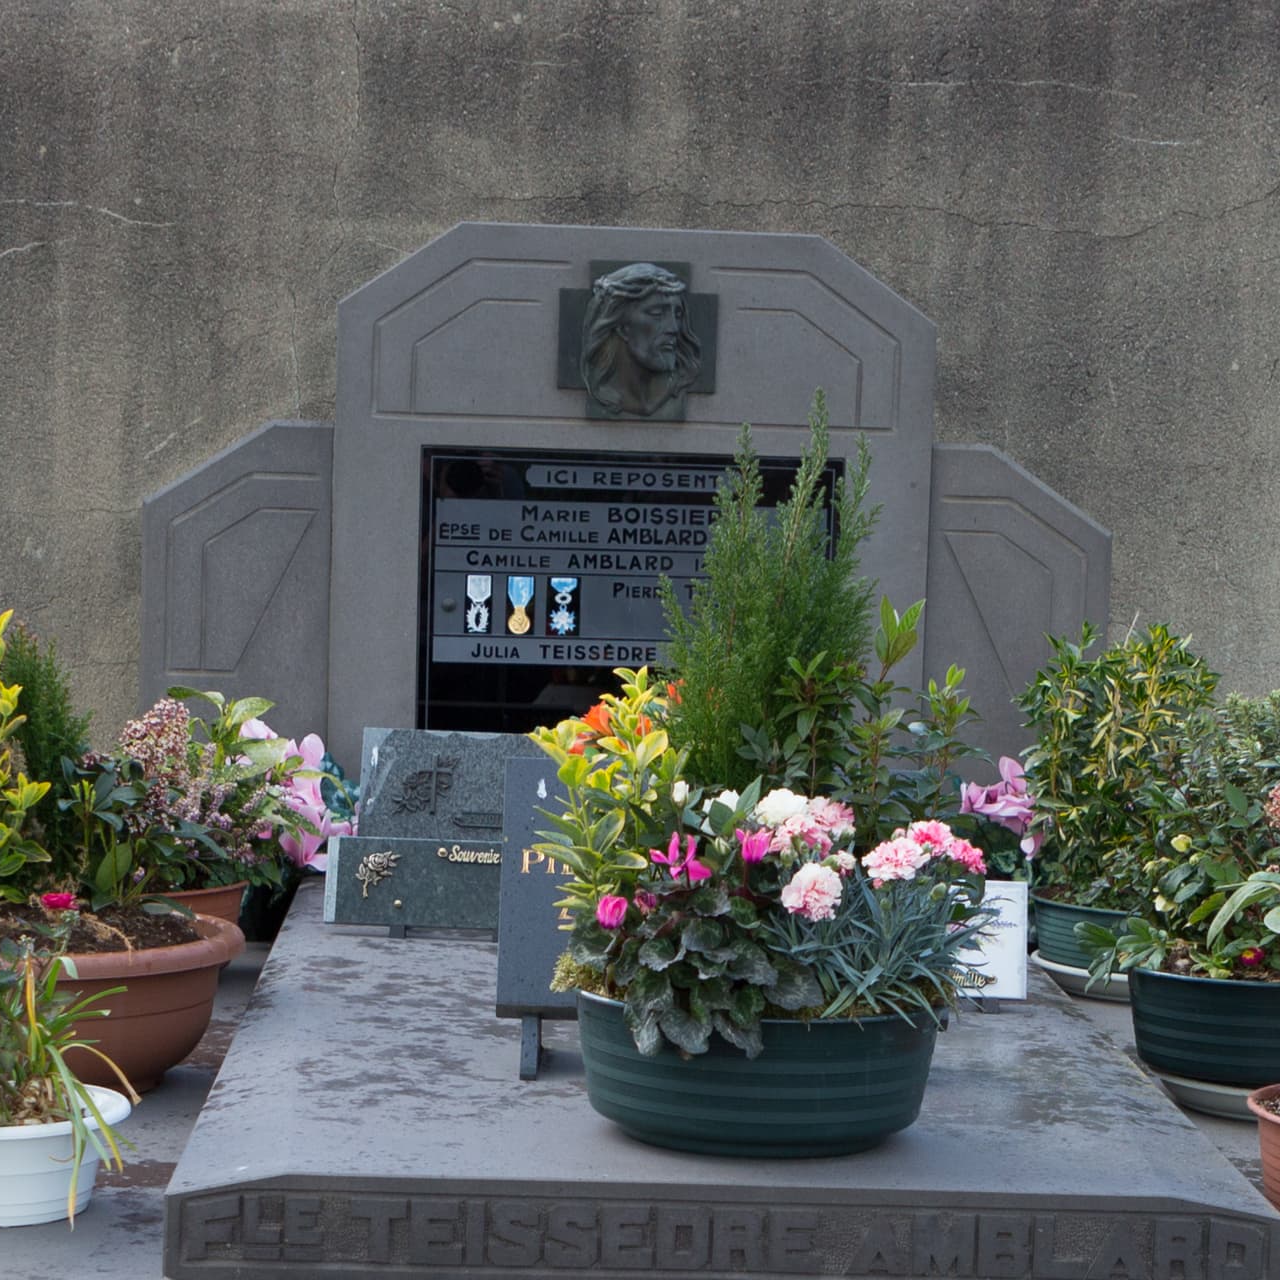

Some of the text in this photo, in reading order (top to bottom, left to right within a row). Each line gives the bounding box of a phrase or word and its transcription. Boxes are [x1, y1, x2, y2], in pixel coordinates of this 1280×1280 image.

[546, 469, 719, 489] ICI REPOSENT
[521, 505, 591, 523] MARIE
[489, 528, 513, 542] DE
[520, 525, 599, 544] CAMILLE
[607, 528, 708, 547] AMBLARD
[466, 550, 551, 569] CAMILLE
[567, 554, 674, 571] AMBLARD
[471, 643, 521, 660] JULIA
[449, 845, 501, 864] Souvenir
[350, 1198, 818, 1274] TEISSEDRE
